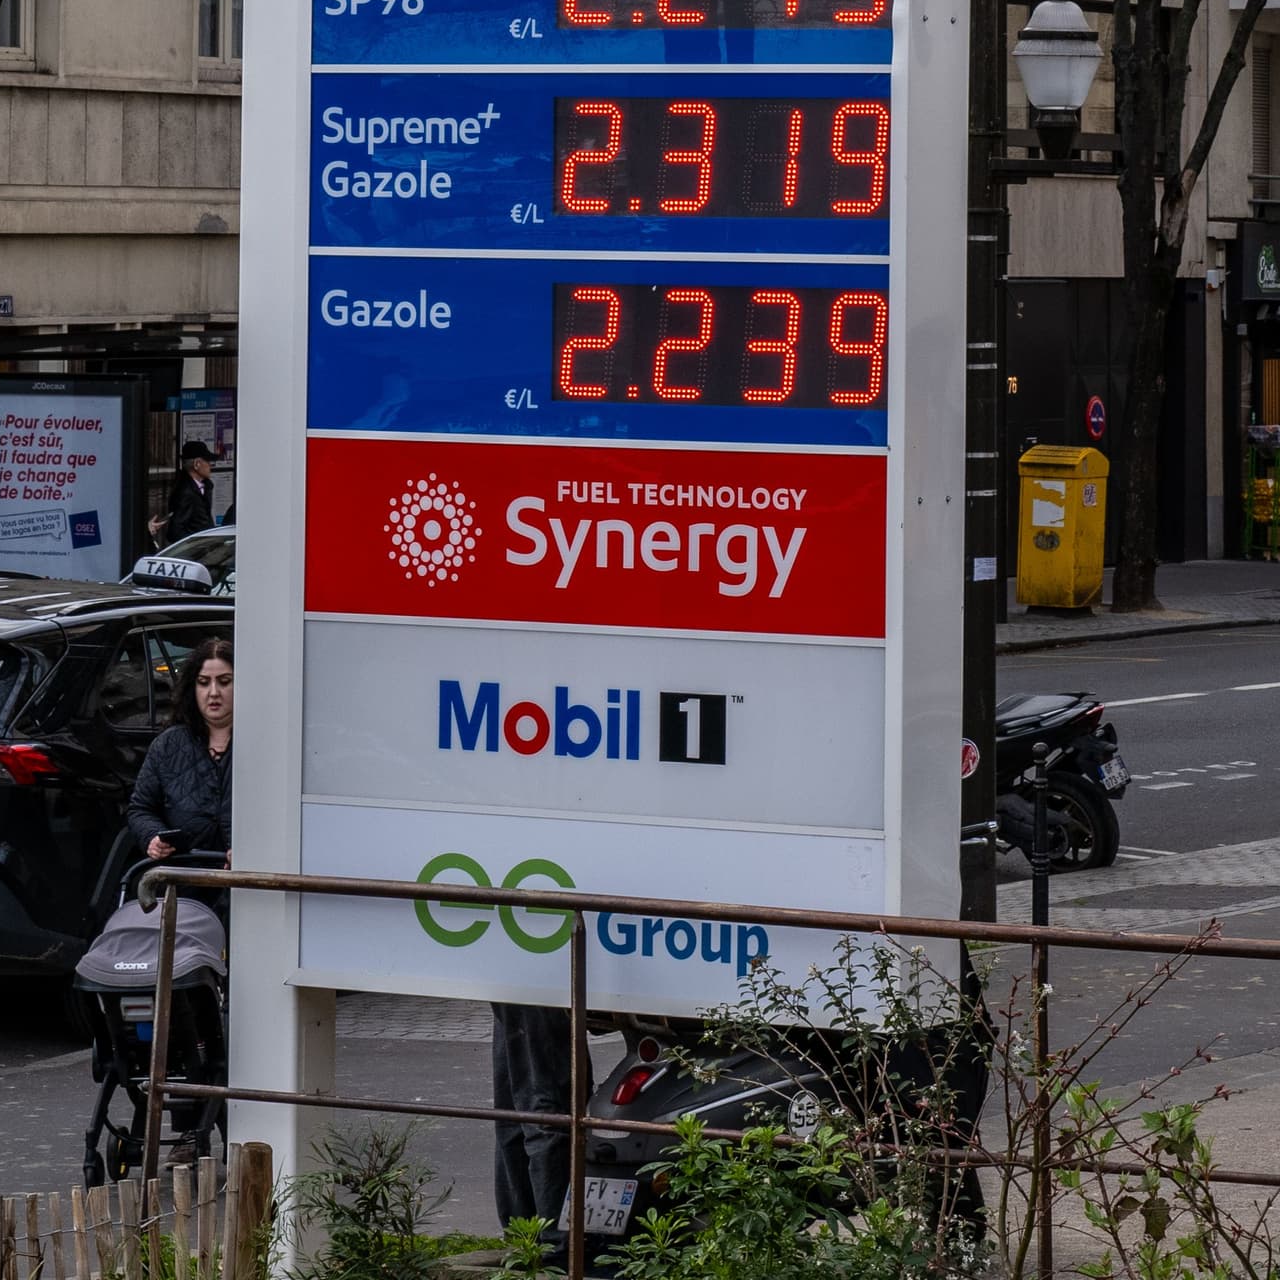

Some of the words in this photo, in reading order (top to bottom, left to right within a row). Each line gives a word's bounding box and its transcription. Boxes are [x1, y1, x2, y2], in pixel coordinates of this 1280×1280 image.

[509, 19, 543, 39] €/L
[322, 103, 501, 155] Supreme+
[561, 102, 889, 214] 2.319
[321, 160, 452, 199] Gazole
[510, 204, 544, 224] €/L
[320, 289, 452, 328] Gazole
[560, 288, 888, 404] 2.239
[32, 382, 65, 390] JCDecaux
[504, 389, 538, 409] €/L
[43, 414, 103, 434] évoluer,
[0, 432, 34, 447] c'est
[38, 432, 64, 450] sûr,
[12, 450, 61, 465] faudra
[67, 455, 96, 469] que
[17, 469, 76, 487] change
[557, 481, 619, 505] FUEL
[628, 482, 807, 512] TECHNOLOGY
[1, 519, 17, 528] Vous
[18, 518, 35, 526] avez
[46, 514, 60, 522] tous
[1, 528, 11, 536] les
[12, 526, 31, 536] logos
[42, 523, 55, 531] bas
[506, 496, 807, 598] Synergy
[147, 561, 187, 578] TAXI
[438, 679, 640, 761] Mobil
[597, 912, 769, 978] Group
